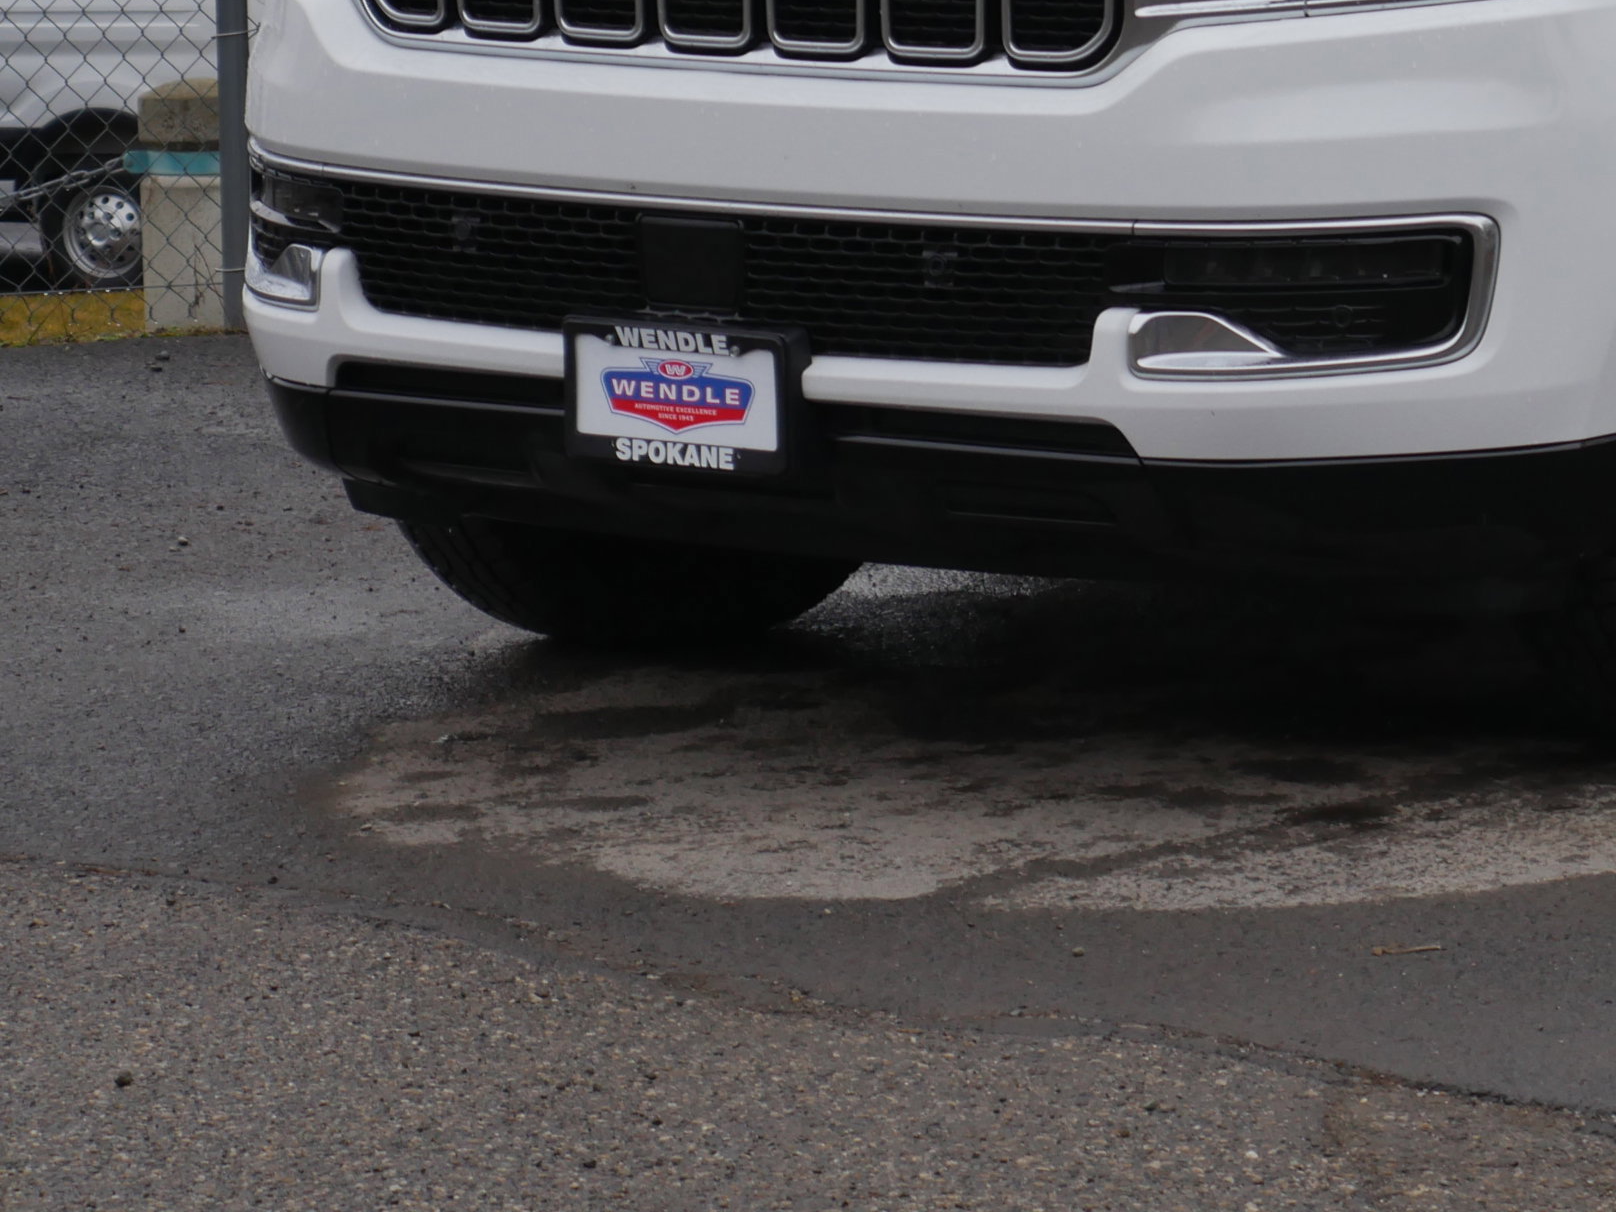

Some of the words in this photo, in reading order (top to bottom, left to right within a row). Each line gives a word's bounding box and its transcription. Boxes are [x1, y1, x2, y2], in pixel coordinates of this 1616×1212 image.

[615, 325, 733, 357] WENDLE
[611, 378, 741, 406] WENDLE
[634, 403, 675, 413] AUTOMOTIVE
[675, 406, 718, 416] EXCELLENCE
[658, 413, 678, 421] SINCE
[615, 437, 735, 471] SPOKANE
